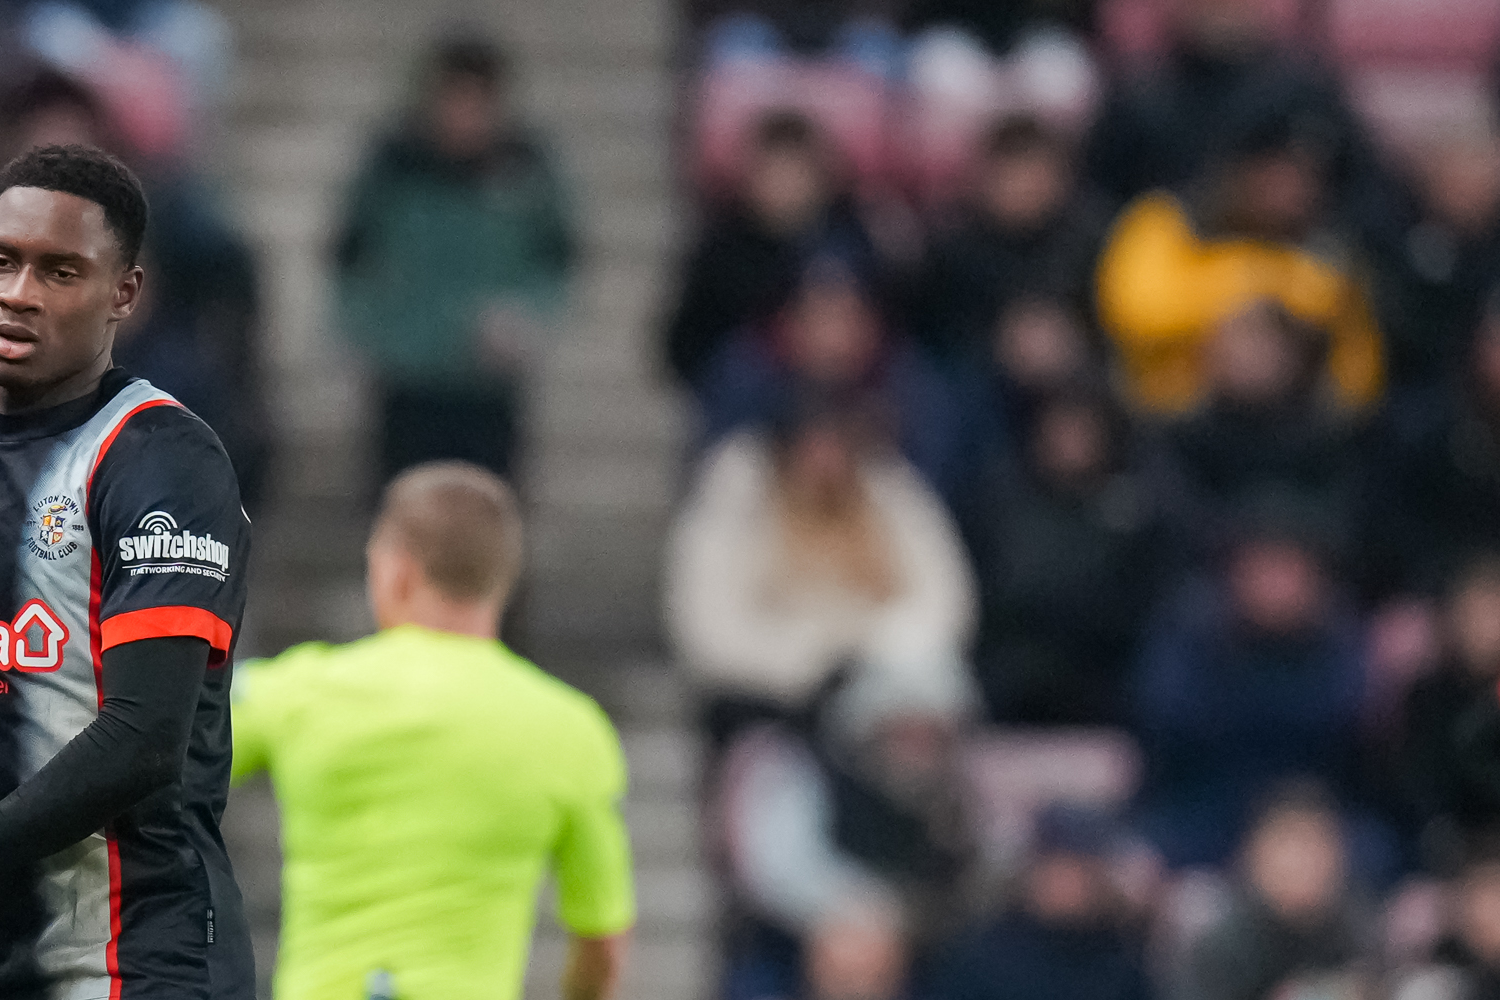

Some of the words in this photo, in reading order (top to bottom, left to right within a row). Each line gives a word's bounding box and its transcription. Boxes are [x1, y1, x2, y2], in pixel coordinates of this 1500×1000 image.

[33, 495, 59, 512] LUTON
[60, 495, 80, 515] TOWN
[26, 536, 57, 560] FOOTBALL
[58, 541, 78, 558] CLUB
[119, 527, 229, 572] switchshop
[185, 567, 202, 575] AND
